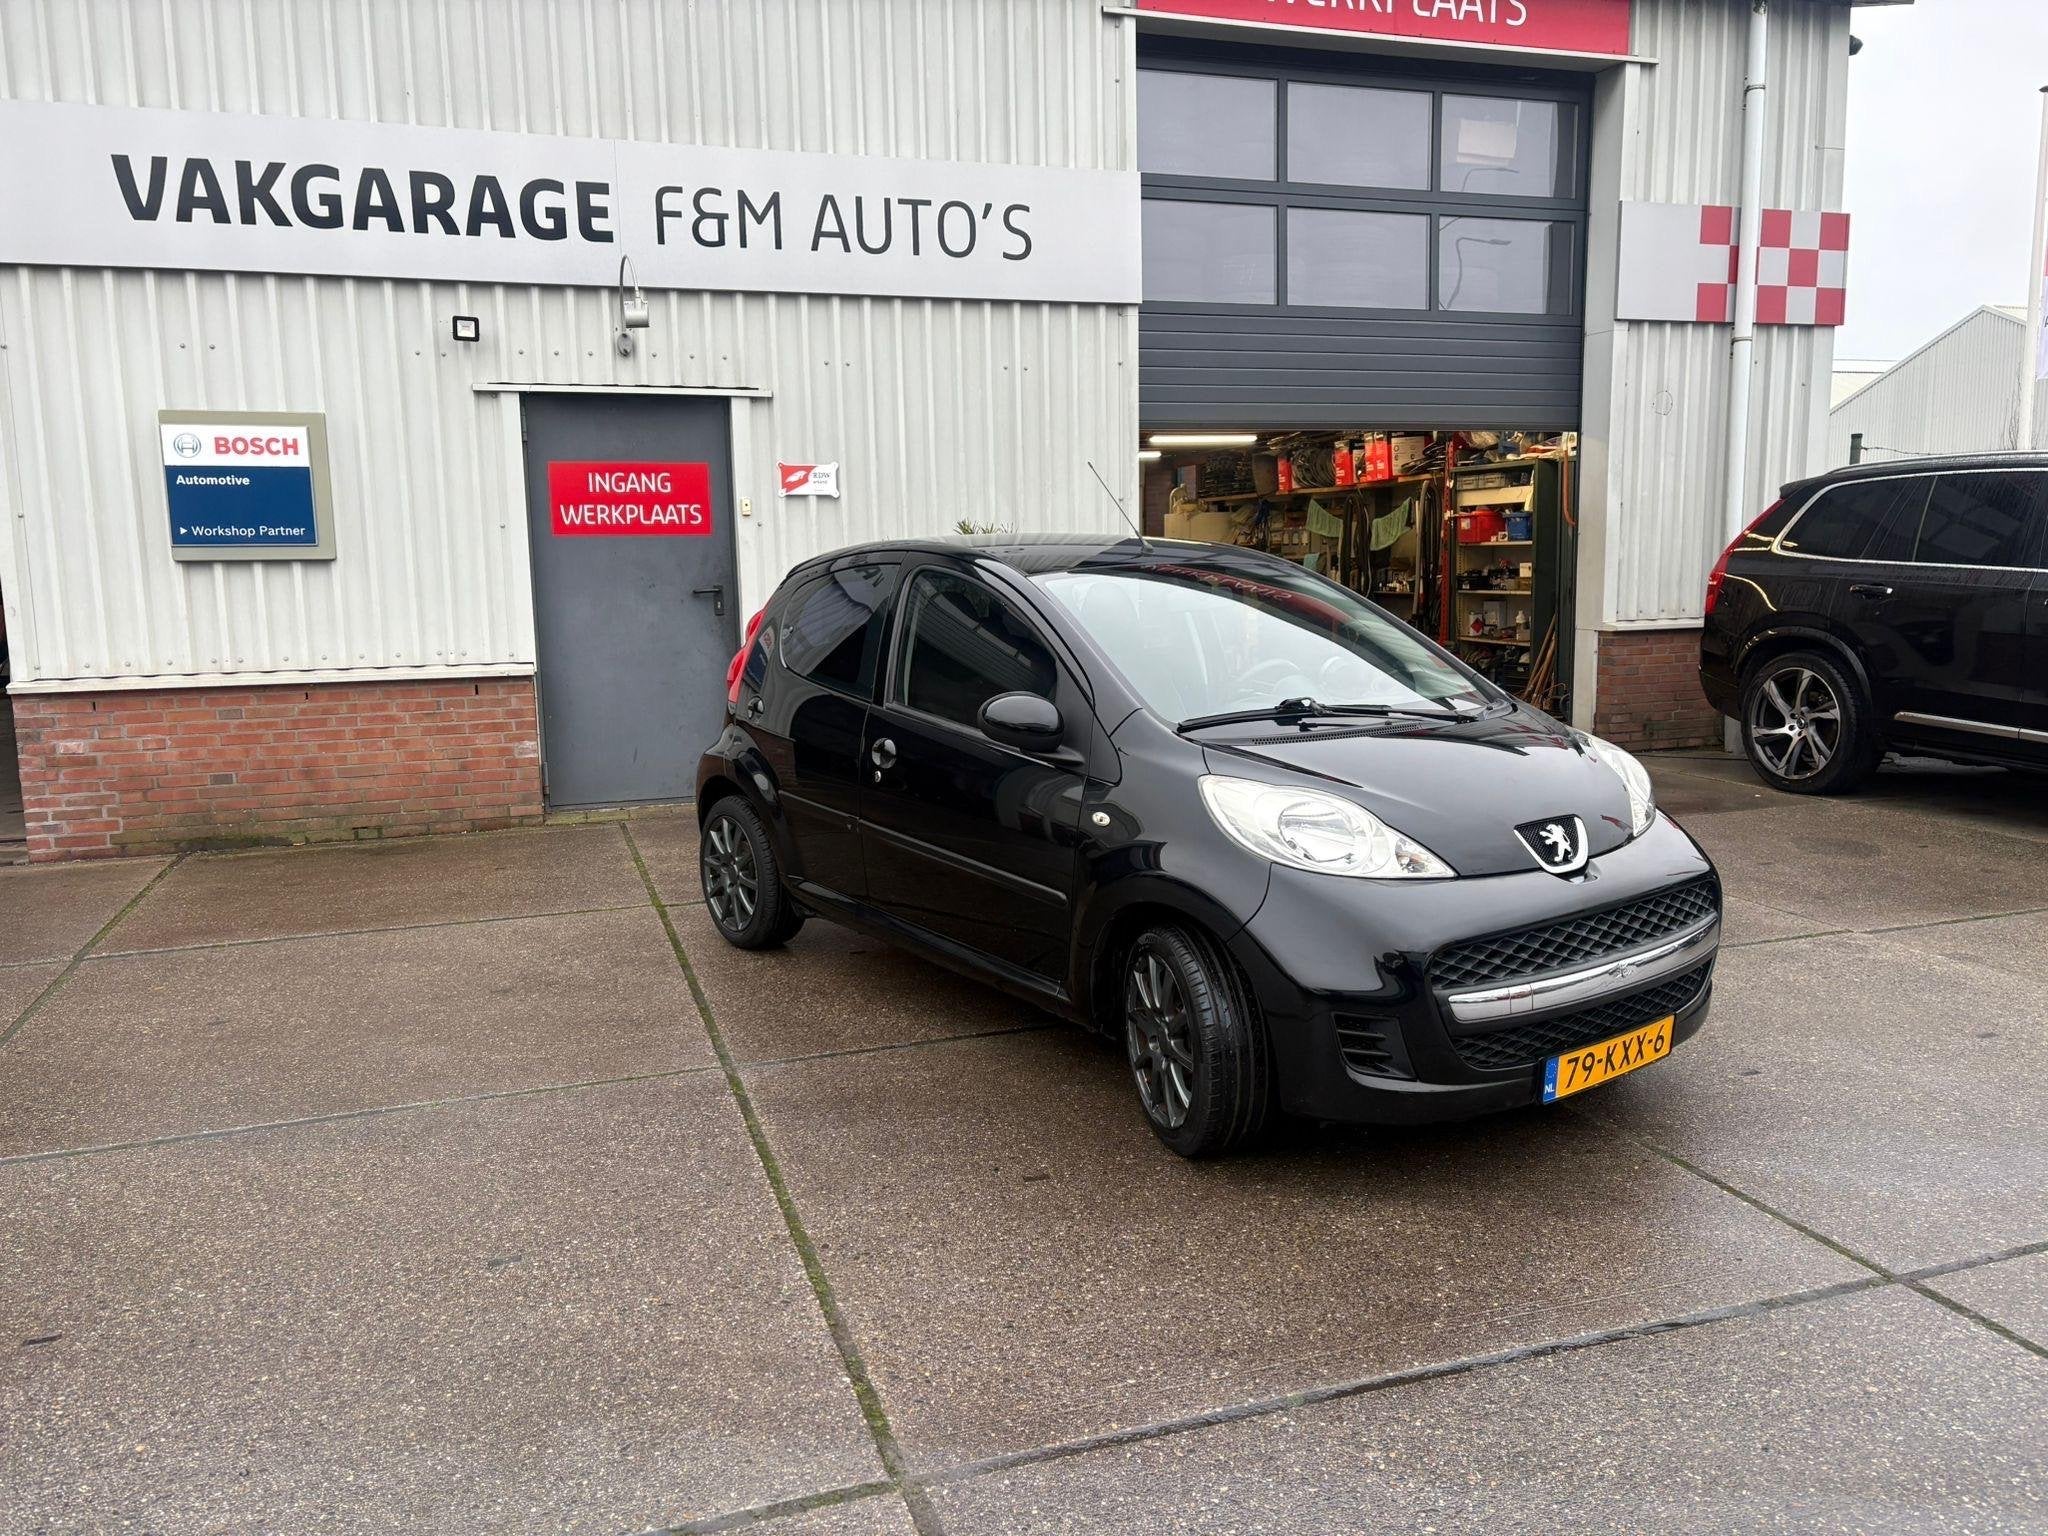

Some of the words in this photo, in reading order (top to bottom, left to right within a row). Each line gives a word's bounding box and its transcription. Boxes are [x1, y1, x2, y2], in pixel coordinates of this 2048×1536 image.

[1266, 0, 1528, 26] LAATS
[111, 154, 614, 243] VAKGARAGE
[655, 186, 783, 250] F&M
[811, 194, 1032, 261] AUTO'S
[214, 437, 299, 455] BOSCH
[176, 475, 250, 485] Automotive
[588, 472, 672, 493] INGANG
[560, 504, 703, 525] WERKPLAATS
[191, 526, 256, 538] Workshop
[259, 526, 306, 536] Partner
[1565, 1024, 1665, 1089] 79-KXX-6
[1544, 1083, 1555, 1095] NL
